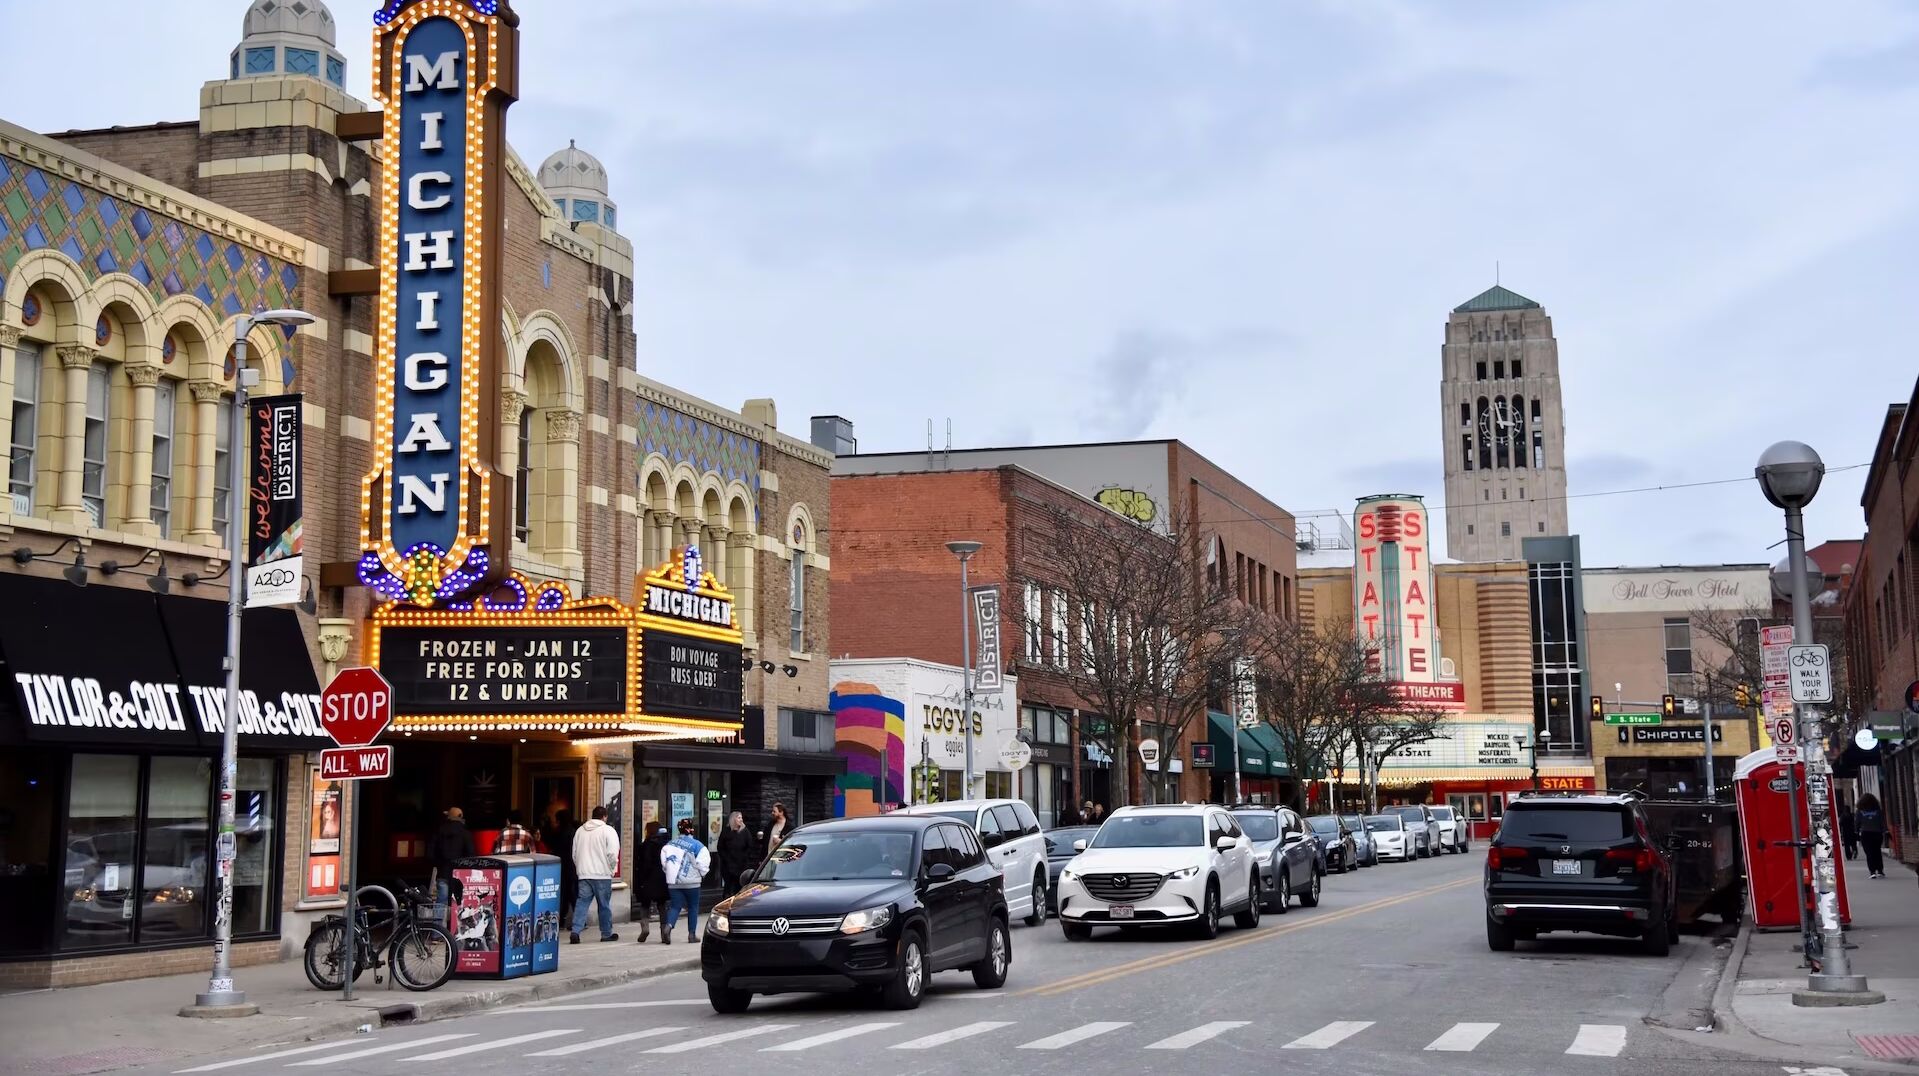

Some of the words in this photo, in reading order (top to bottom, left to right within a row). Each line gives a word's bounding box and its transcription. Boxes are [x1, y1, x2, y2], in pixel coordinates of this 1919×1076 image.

[397, 51, 460, 514] MICHIGAN
[278, 411, 292, 495] DISTRICT
[250, 403, 272, 539] welcome
[1359, 511, 1382, 674] STATE
[1402, 511, 1427, 673] STATE
[1612, 579, 1649, 600] Bell
[1652, 578, 1694, 600] Tower
[1697, 578, 1739, 599] Hotel
[649, 586, 732, 626] MICHIGAN
[419, 640, 496, 657] FROZEN
[524, 640, 562, 657] JAN
[573, 640, 591, 657] 12
[979, 595, 996, 683] DISTRICT
[670, 646, 686, 662] BON
[689, 649, 719, 668] VOYAGE
[426, 662, 476, 679] FREE
[486, 662, 525, 679] FOR
[535, 662, 582, 679] KIDS
[670, 667, 691, 683] RUSS
[1800, 669, 1820, 677] WALK
[450, 684, 469, 701] 12
[478, 684, 490, 701] &
[501, 684, 569, 701] UNDER
[1408, 685, 1454, 699] THEATRE
[1800, 679, 1821, 687] YOUR
[1803, 689, 1821, 697] BIKE
[188, 685, 331, 737] TAYOR&COLT
[325, 691, 387, 723] STOP
[923, 704, 983, 737] IGGYS
[1637, 730, 1703, 739] CHIPOTLE
[323, 755, 349, 774] ALL
[359, 753, 387, 772] WAY
[1542, 778, 1584, 788] STATE
[707, 790, 720, 799] OPEN
[1687, 840, 1712, 848] 20-82
